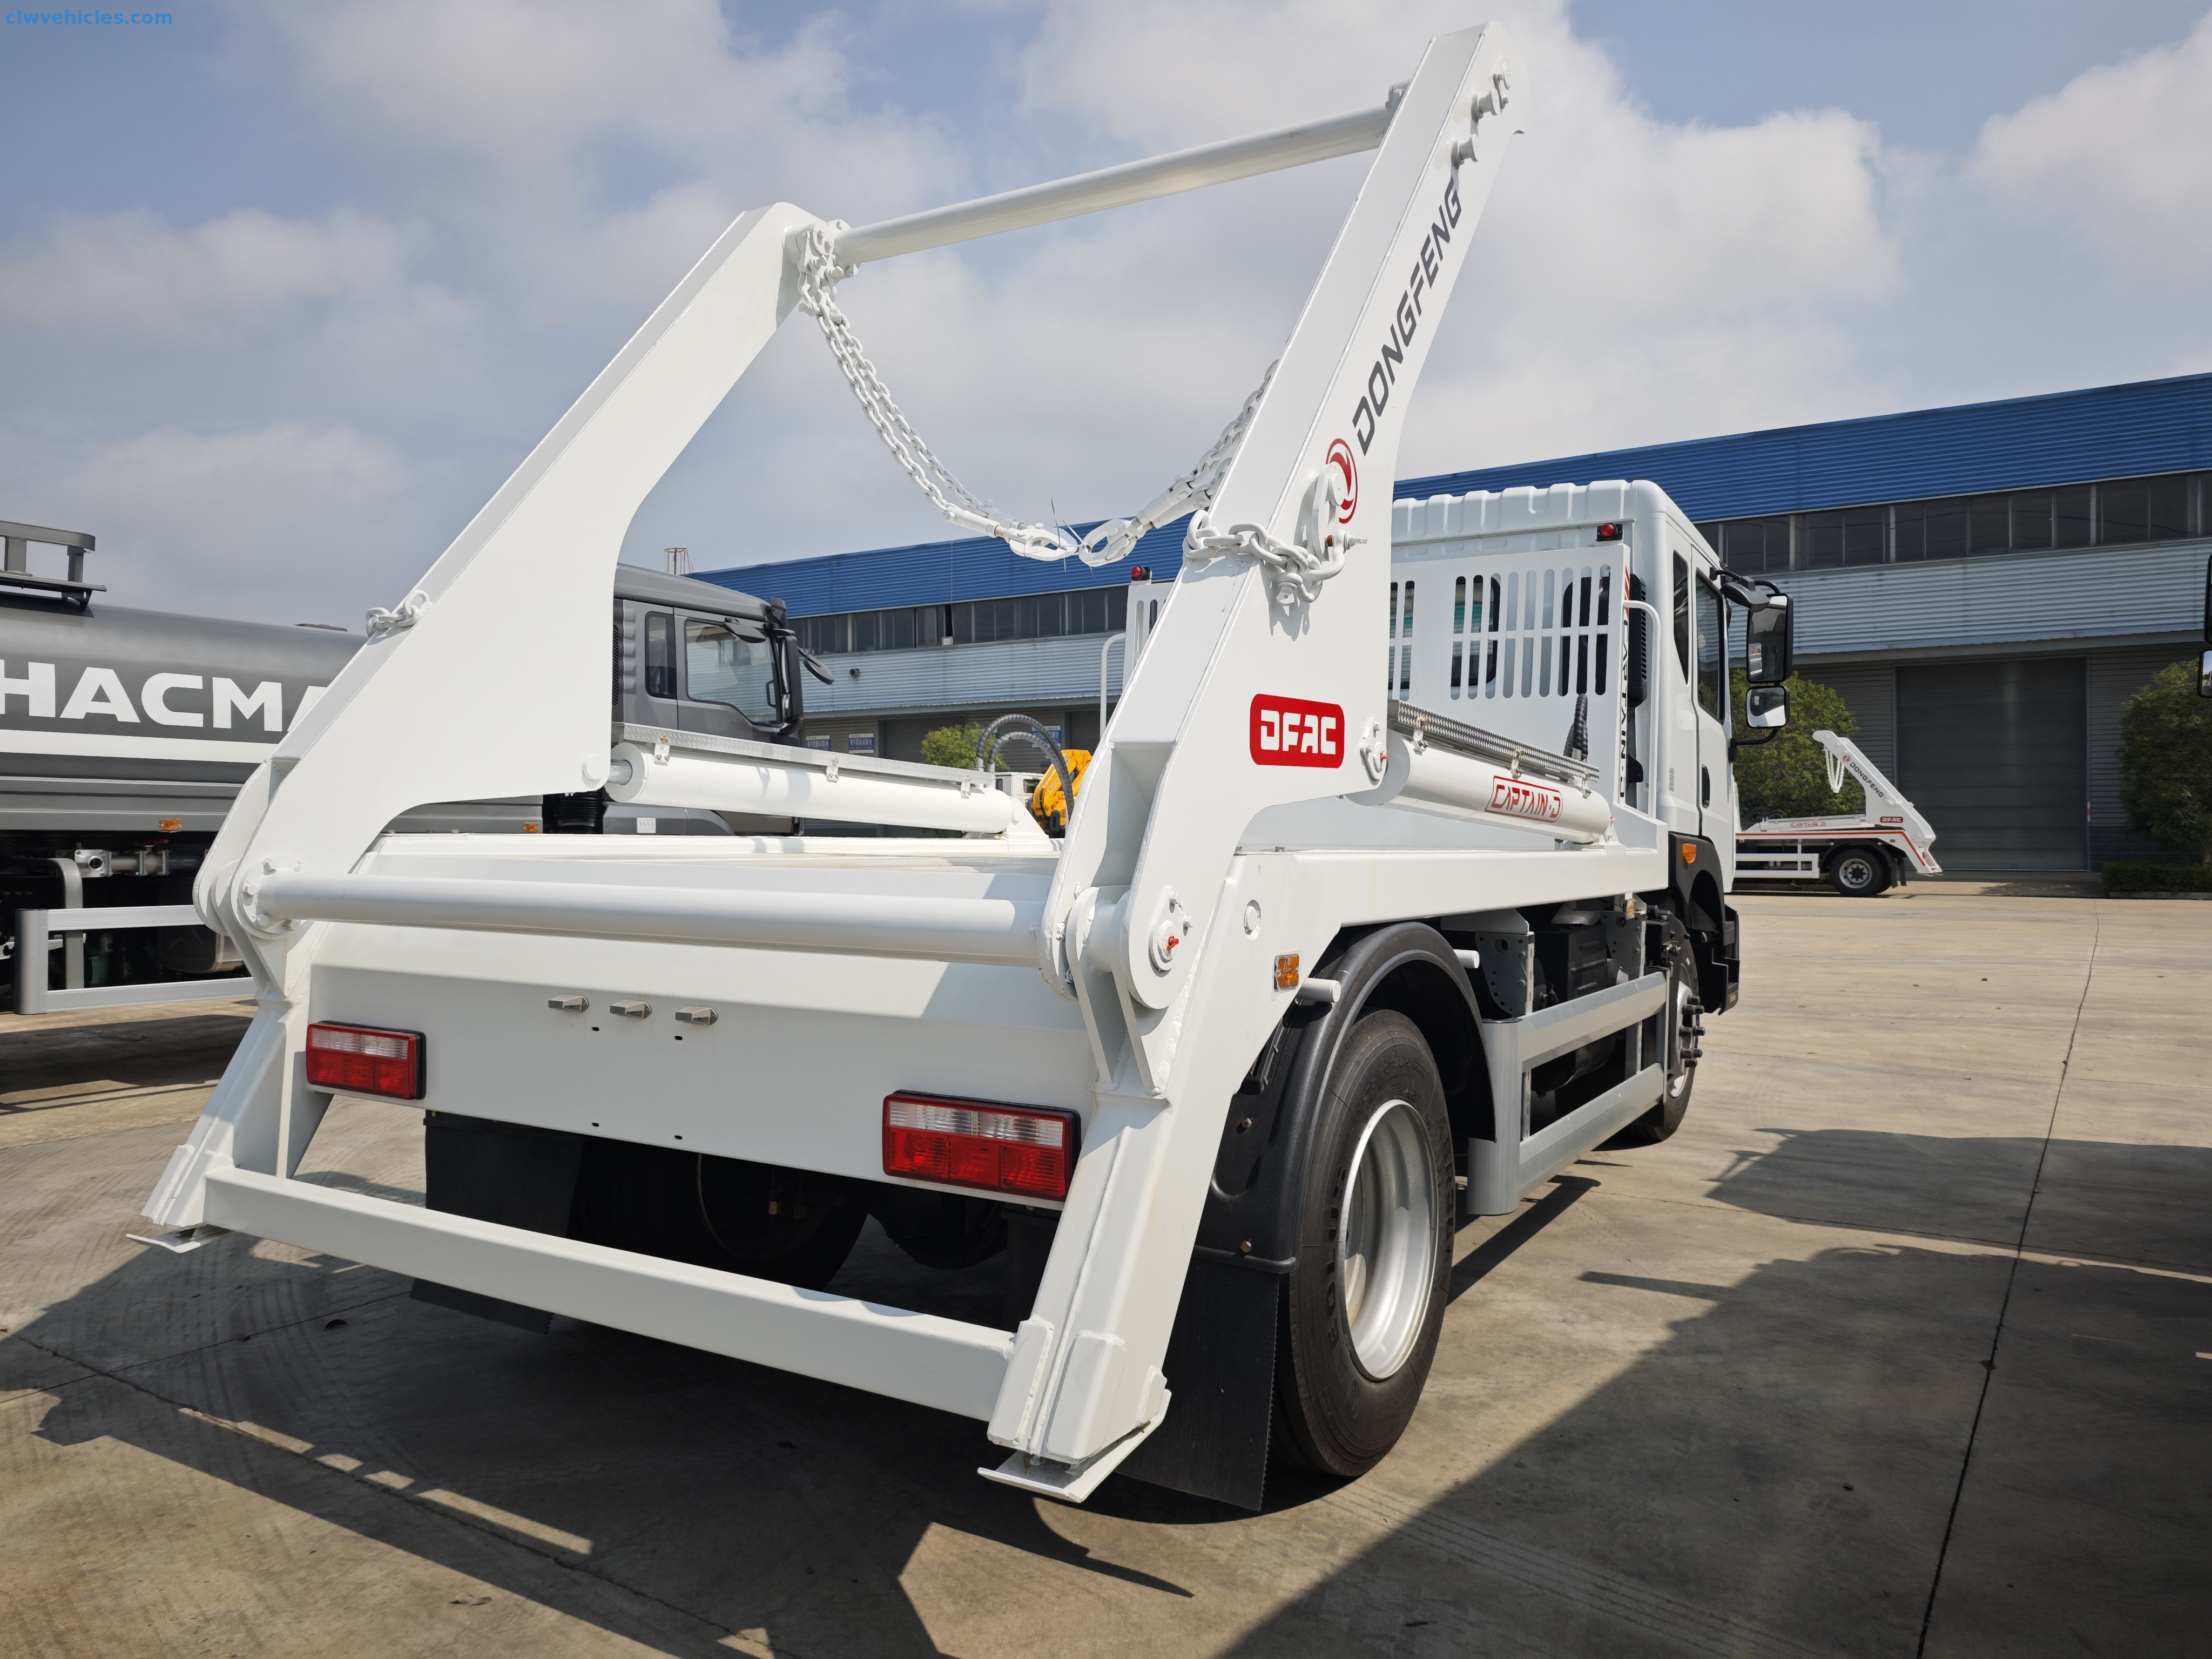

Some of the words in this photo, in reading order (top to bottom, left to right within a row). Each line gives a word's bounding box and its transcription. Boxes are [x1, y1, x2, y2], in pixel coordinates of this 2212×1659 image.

[1352, 177, 1462, 456] DONGFENG
[1260, 709, 1337, 755] DFAC
[1849, 762, 1885, 798] DONGFENG
